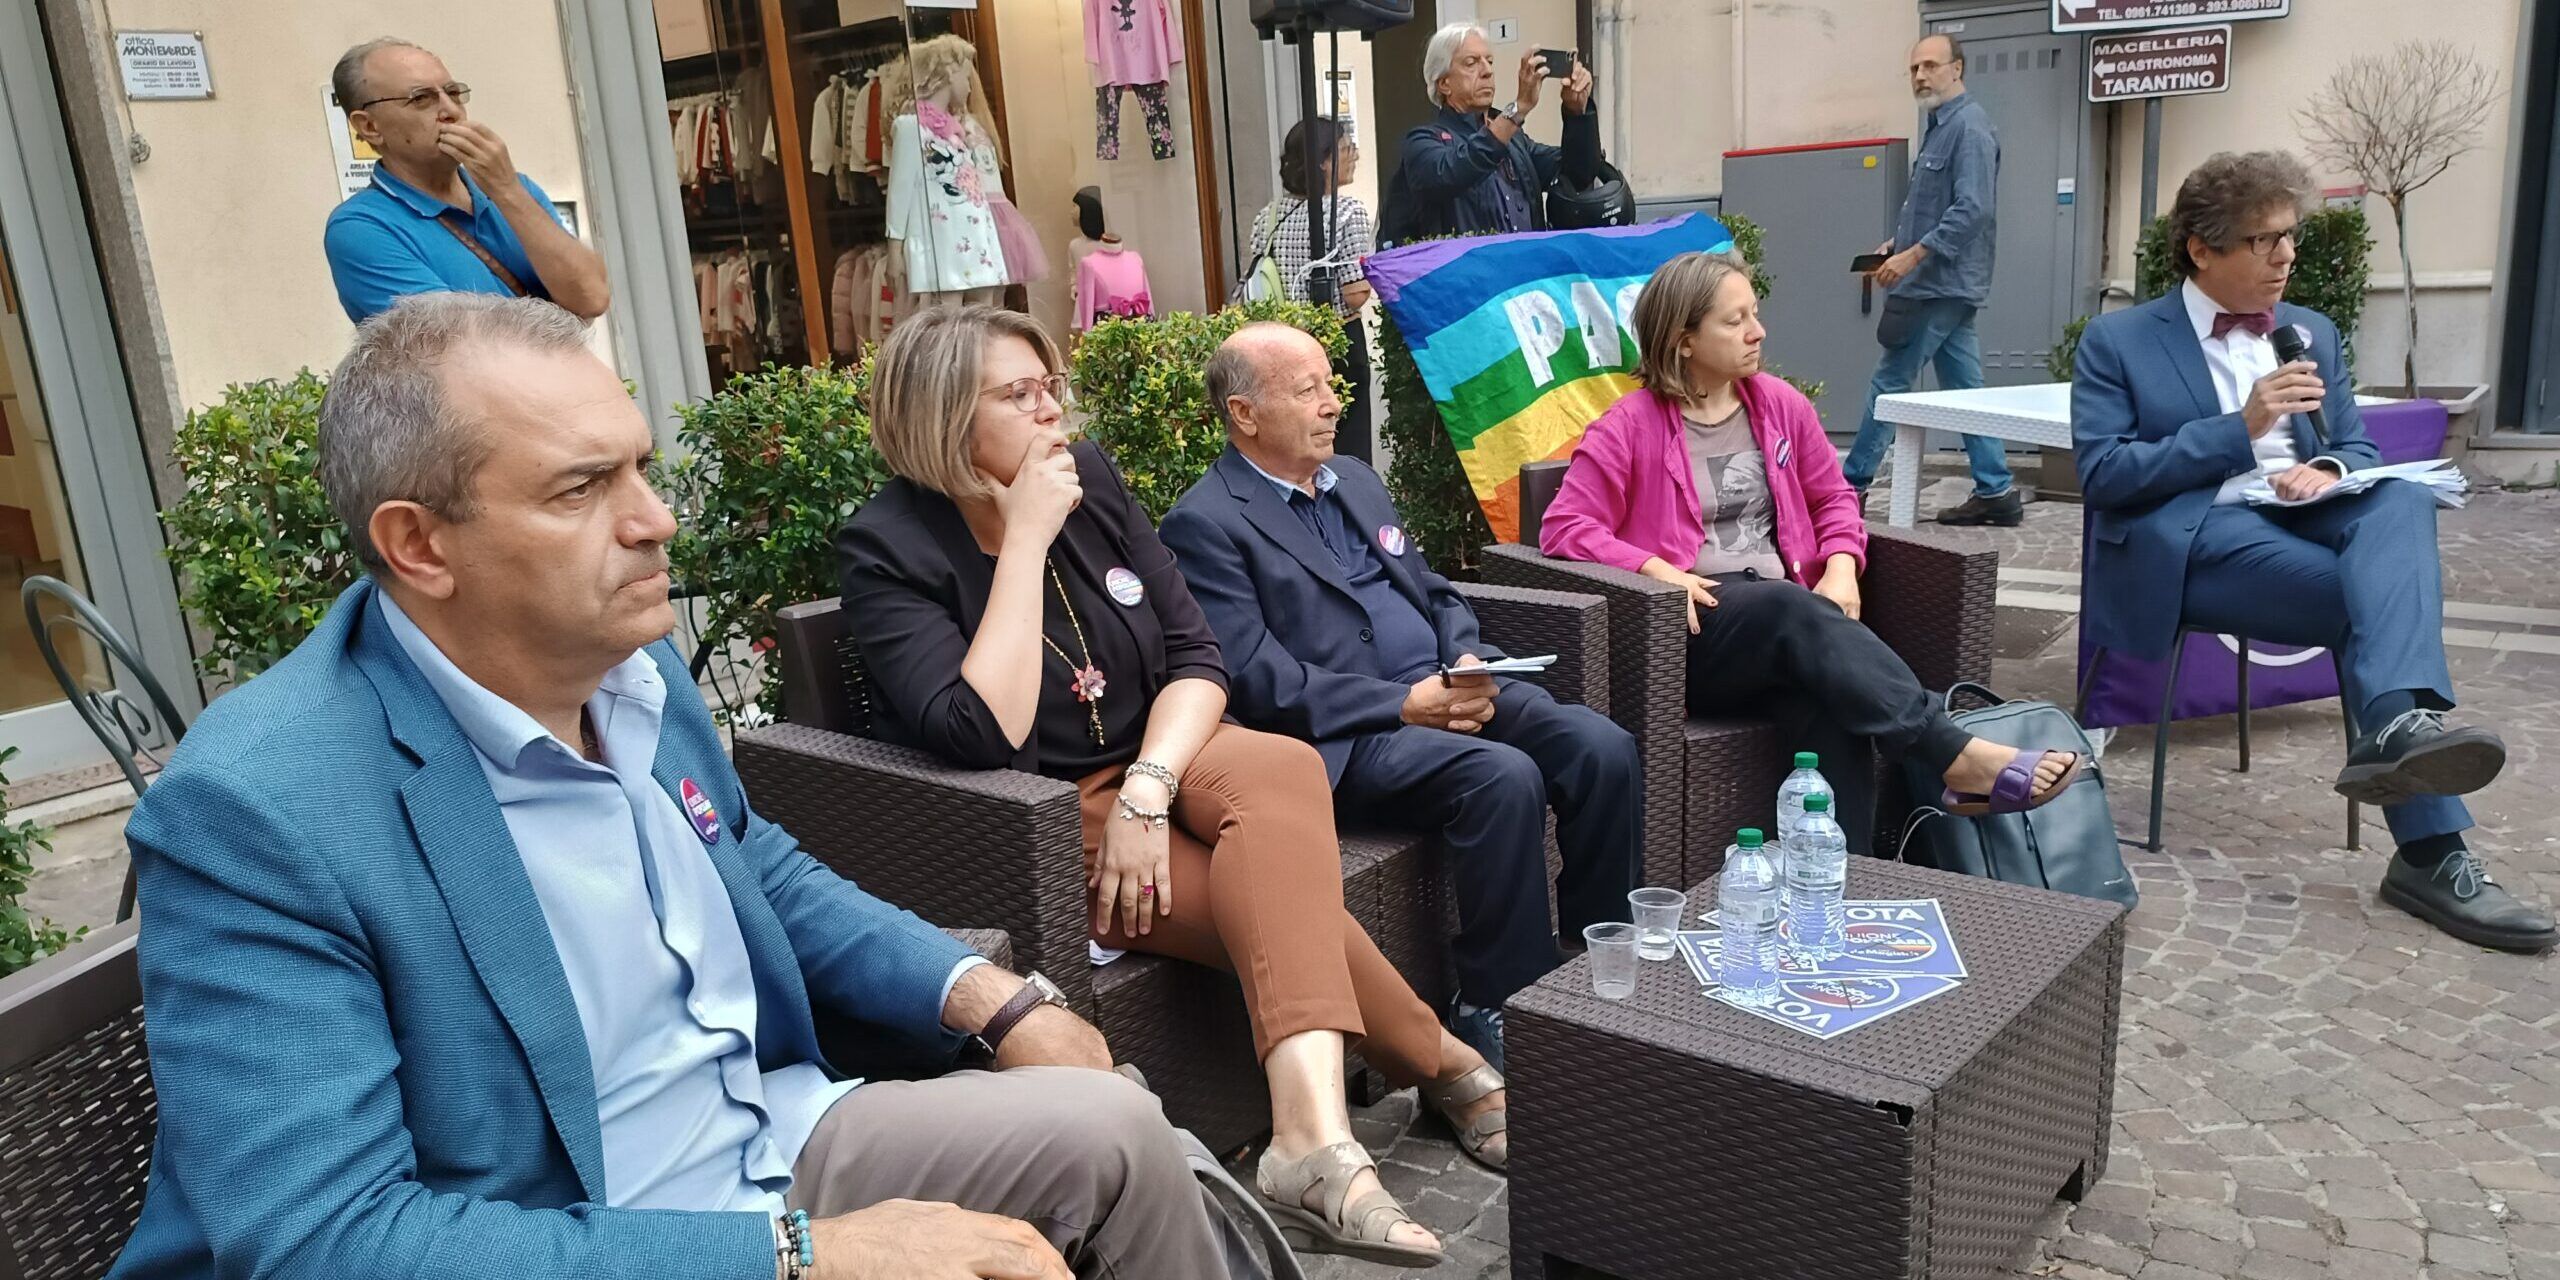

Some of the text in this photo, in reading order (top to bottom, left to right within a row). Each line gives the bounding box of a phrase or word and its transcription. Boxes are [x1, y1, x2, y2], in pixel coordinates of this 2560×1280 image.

[2097, 8, 2123, 20] TEL.
[1500, 23, 1507, 38] 1
[2094, 34, 2224, 56] MACELLERIA
[2116, 53, 2218, 73] GASTRONOMIA
[2101, 70, 2215, 96] TARANTINO
[1502, 281, 1643, 389] PAC
[1842, 906, 1926, 921] OTA
